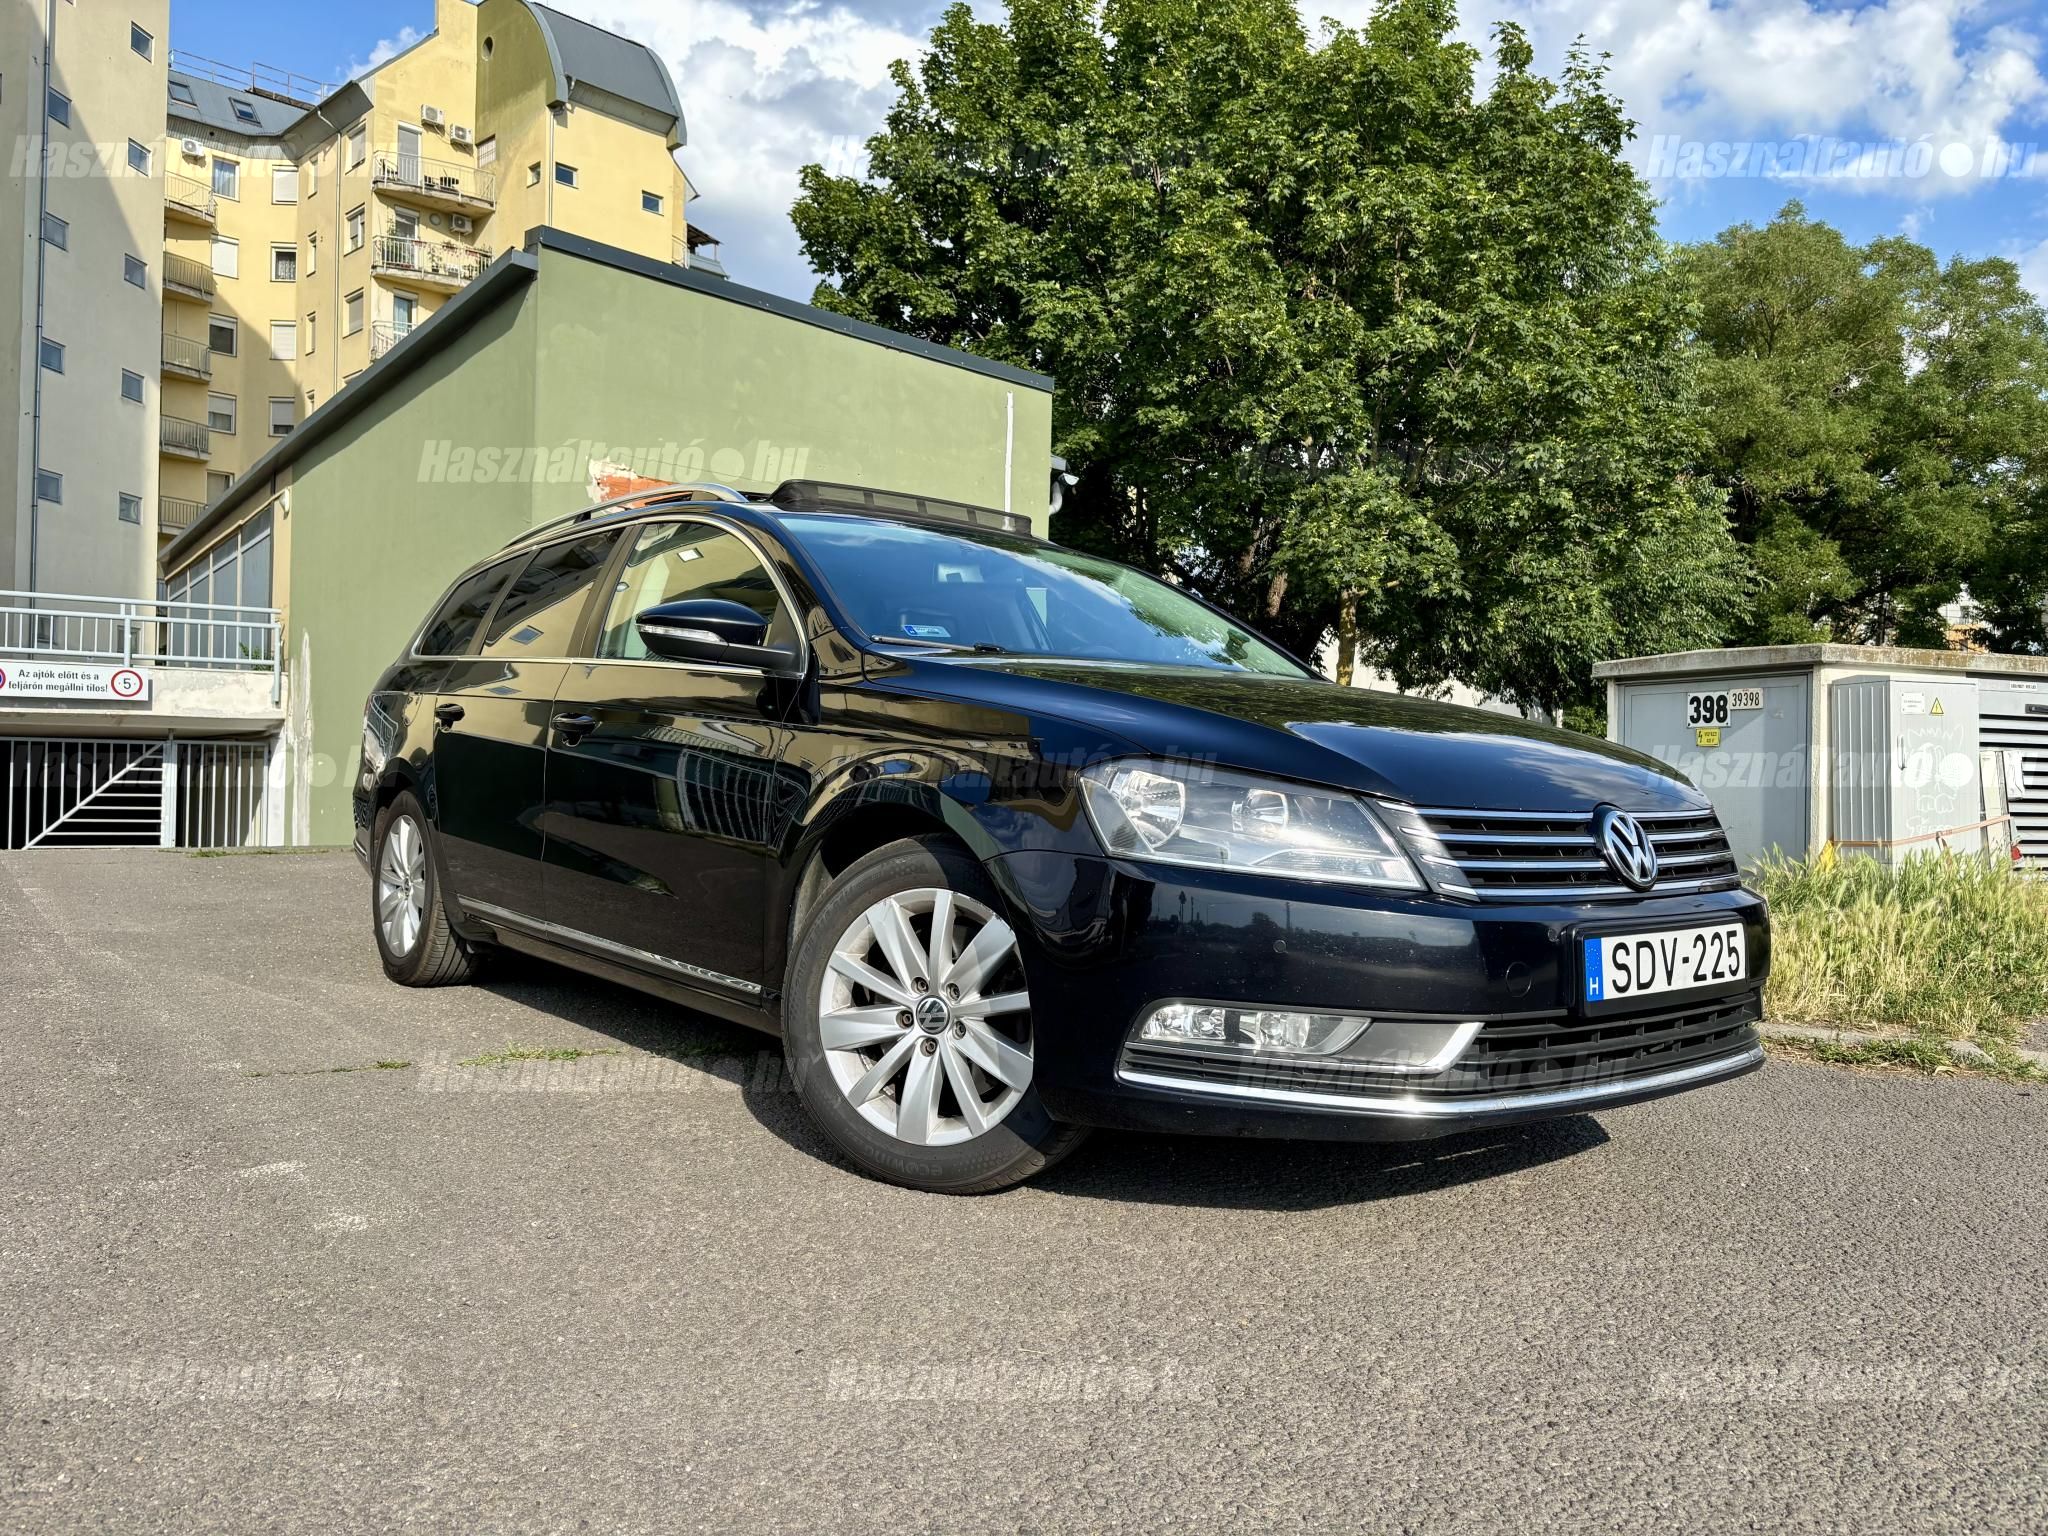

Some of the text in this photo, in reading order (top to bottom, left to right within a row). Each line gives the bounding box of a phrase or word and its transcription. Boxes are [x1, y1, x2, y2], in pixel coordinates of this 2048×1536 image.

[18, 668, 99, 681] Az ajtók előtt és a
[45, 682, 84, 693] megállni
[86, 682, 108, 693] tilos!
[123, 678, 132, 690] 5
[1732, 692, 1760, 708] 39398
[1689, 695, 1728, 724] 398
[1611, 929, 1741, 994] SDV-225
[1589, 976, 1600, 996] H
